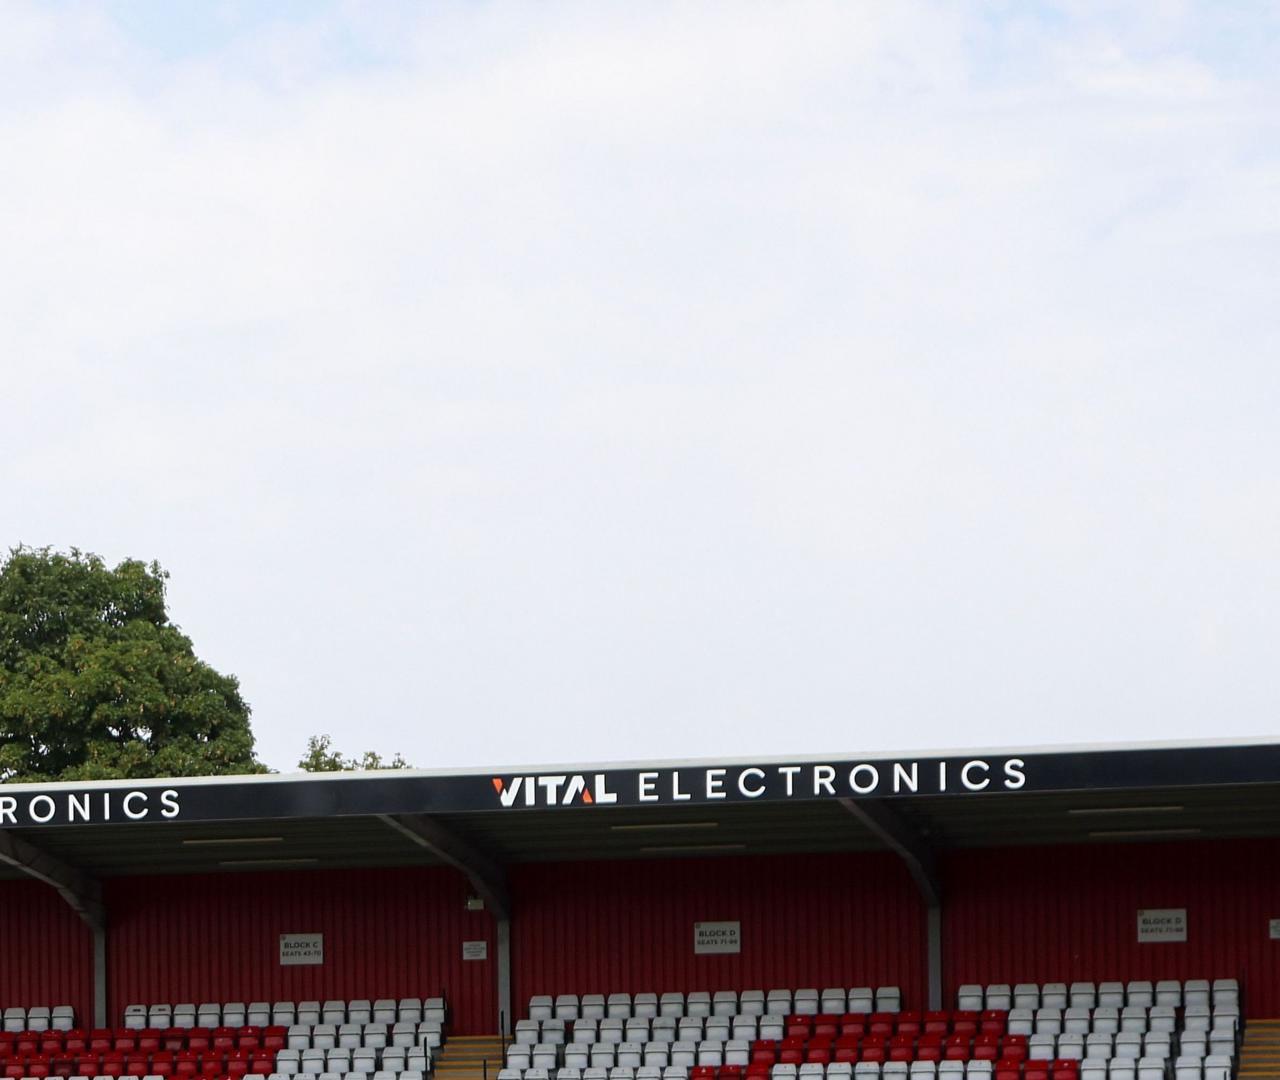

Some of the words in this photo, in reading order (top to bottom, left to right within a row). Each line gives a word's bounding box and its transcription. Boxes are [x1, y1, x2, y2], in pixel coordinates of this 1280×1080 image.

[492, 775, 617, 807] VITAL
[639, 758, 1027, 801] ELECTRONICS
[283, 941, 311, 949] BLOCK
